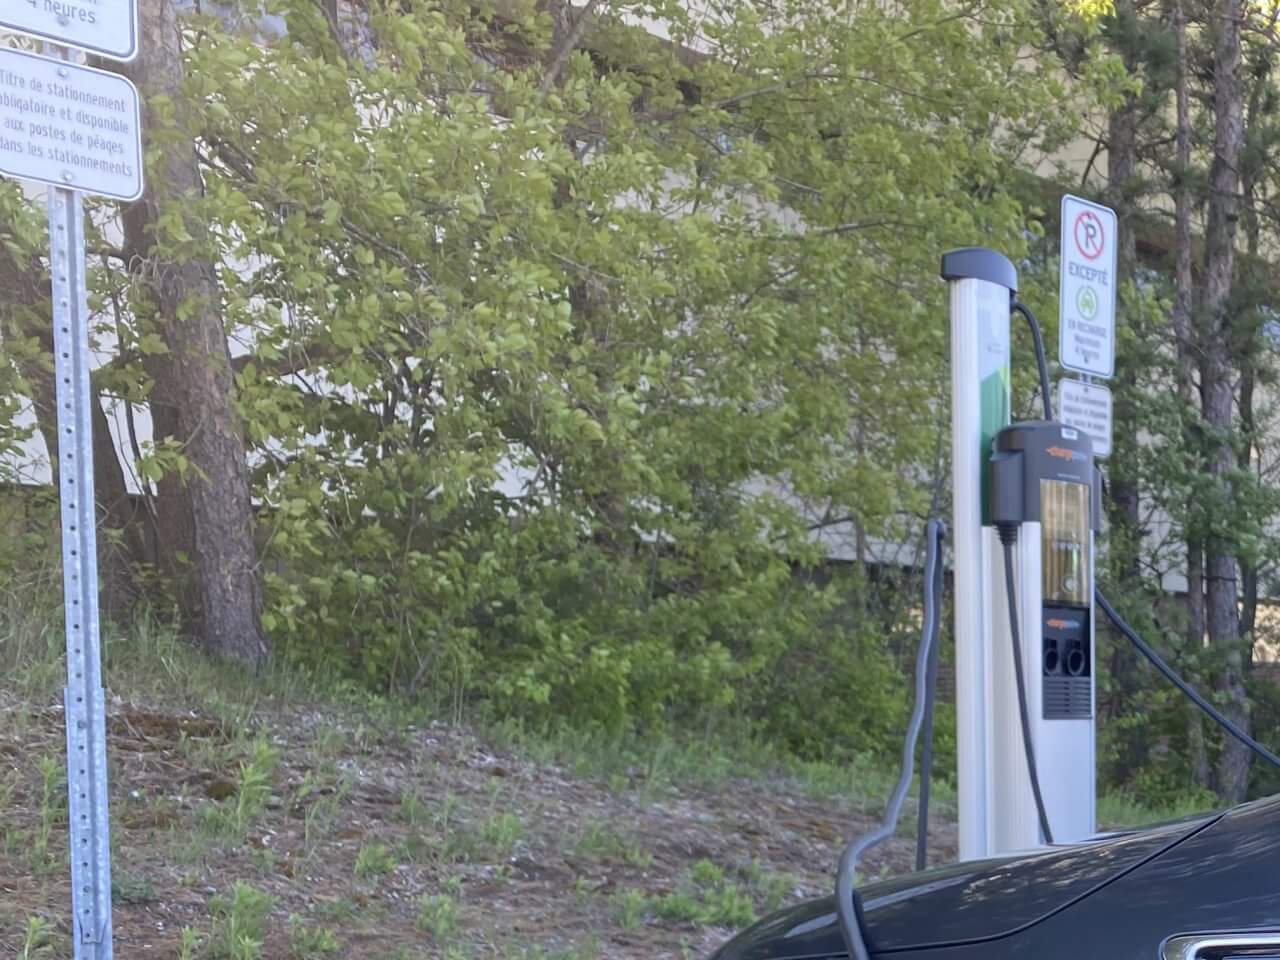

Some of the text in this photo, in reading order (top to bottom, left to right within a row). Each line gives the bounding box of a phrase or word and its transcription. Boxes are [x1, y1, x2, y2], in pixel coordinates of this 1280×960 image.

[44, 0, 96, 24] heures
[0, 68, 127, 113] Titre de stationnement
[4, 117, 124, 157] aux postes de péages
[60, 107, 72, 121] et
[76, 109, 129, 135] disponible
[27, 141, 43, 159] les
[47, 146, 133, 178] stationnements
[1068, 261, 1109, 287] EXCEPTÉ
